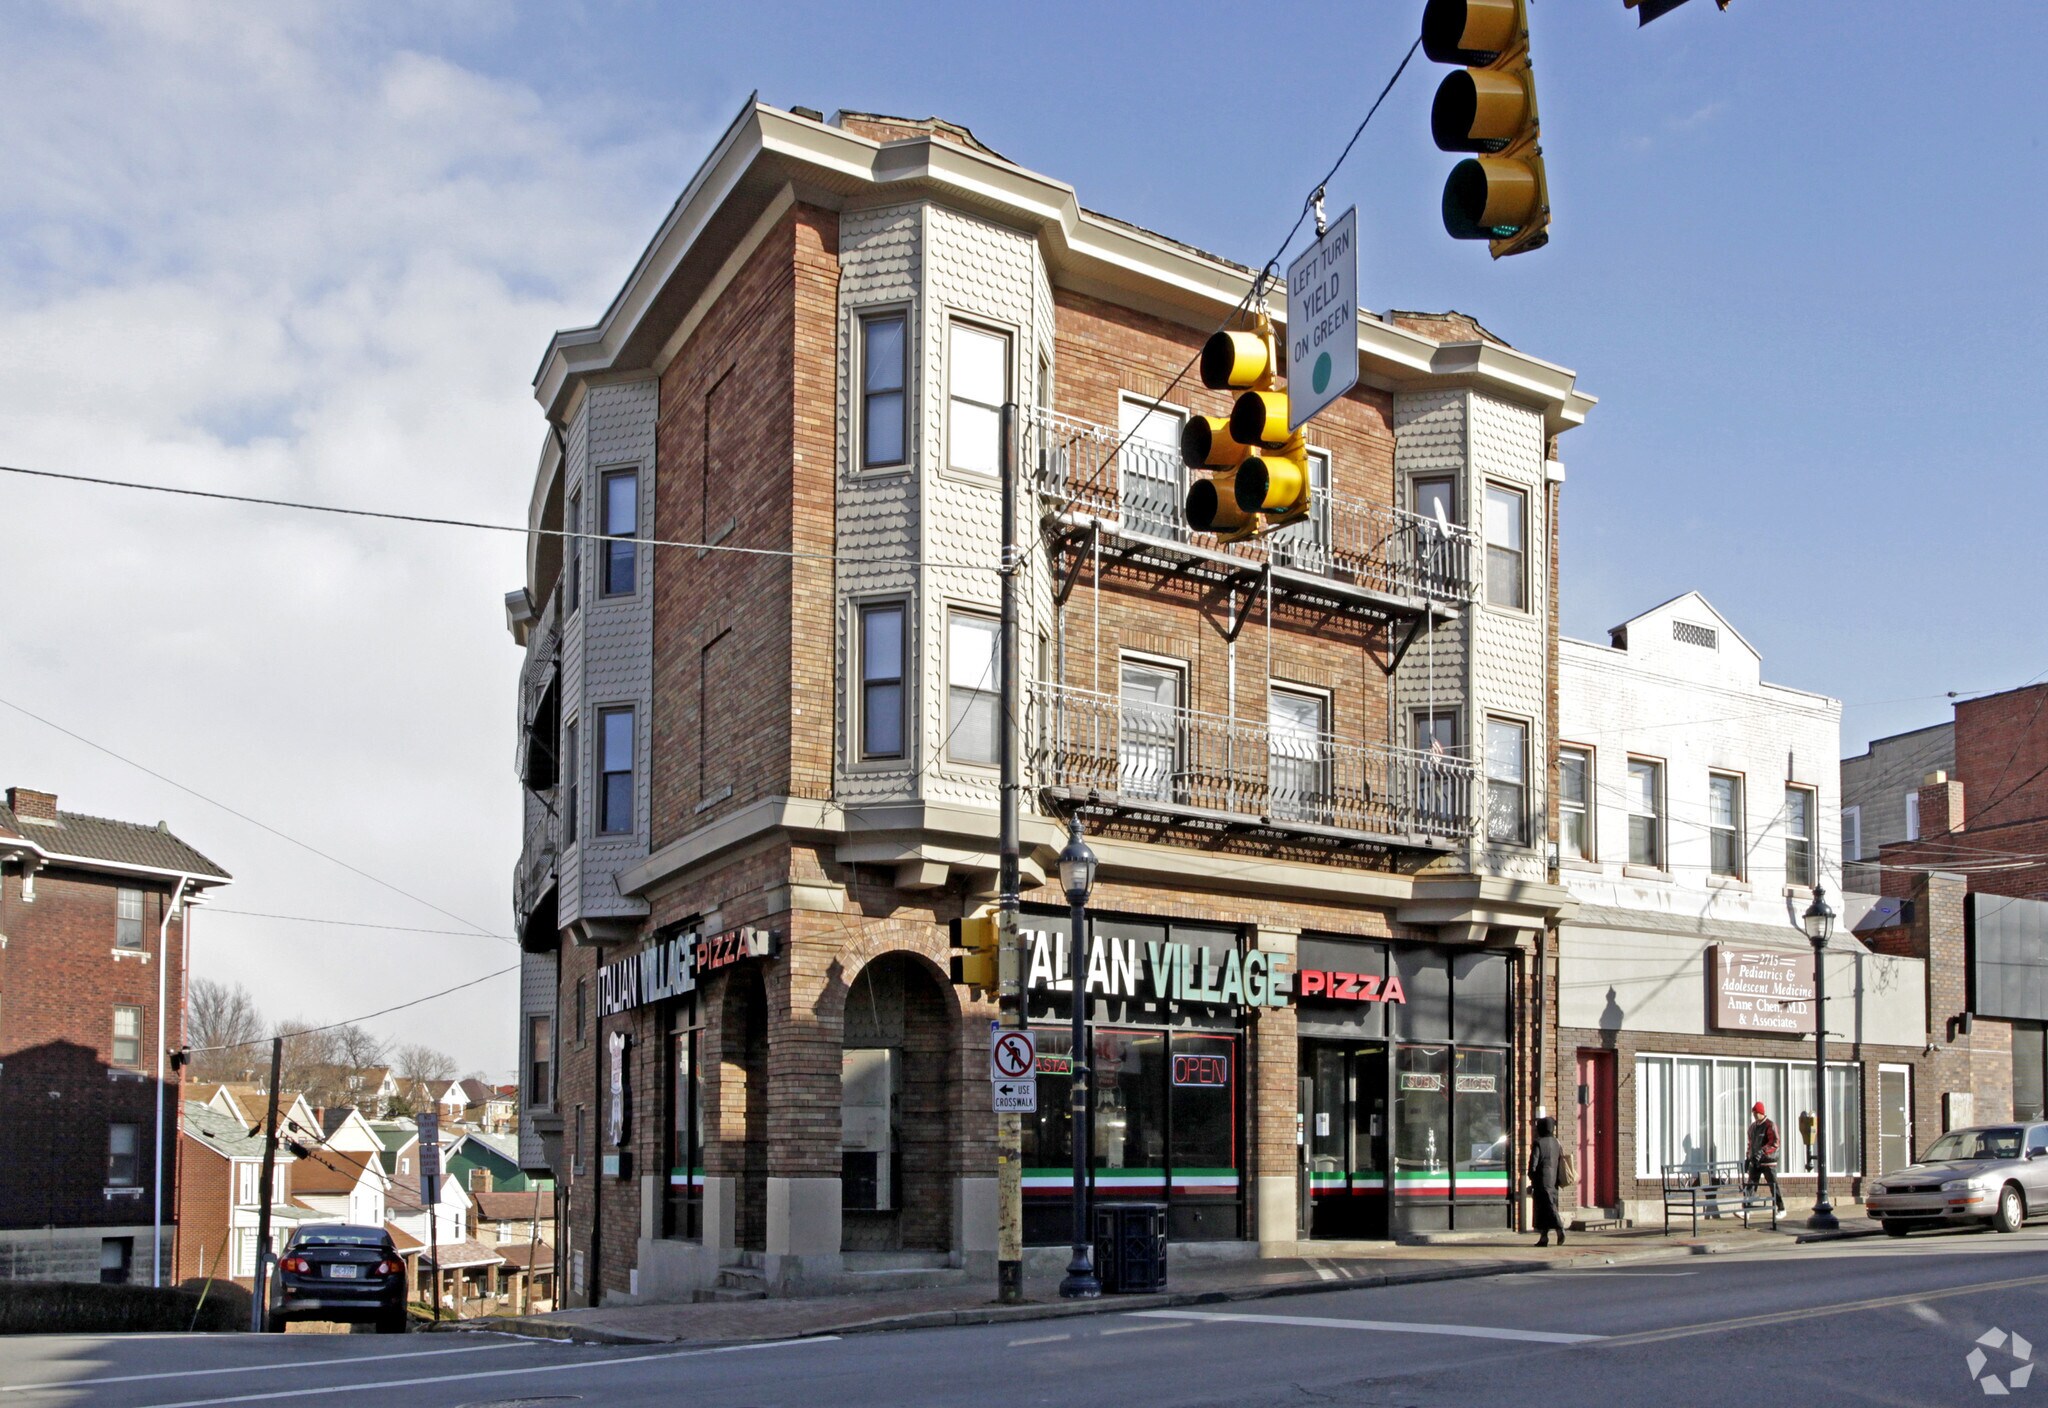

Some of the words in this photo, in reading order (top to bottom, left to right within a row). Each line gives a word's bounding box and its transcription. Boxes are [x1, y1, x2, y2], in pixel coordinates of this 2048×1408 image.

[1293, 257, 1317, 297] LEFT
[1322, 228, 1349, 272] TURN
[1303, 272, 1340, 322] YIELD
[1294, 334, 1309, 363] ON
[1313, 301, 1349, 347] GREEN
[1759, 953, 1779, 966] 2715
[598, 955, 637, 1017] ITALIAN
[640, 932, 696, 1004] VILLAGE
[697, 927, 752, 974] PIZZA
[1148, 941, 1288, 1007] VILLAGE
[1301, 969, 1406, 1004] PIZZA
[1739, 965, 1783, 981] Pediatrics
[1786, 969, 1796, 982] &
[1722, 978, 1768, 993] Adolescent
[1772, 983, 1813, 998] Medicine
[1727, 996, 1753, 1011] Anne
[1786, 1002, 1808, 1015] M.D.
[1739, 1013, 1747, 1025] &
[1752, 1014, 1797, 1028] Associates
[1036, 1058, 1069, 1073] ASTA
[1175, 1057, 1226, 1084] OPEN
[1018, 1085, 1030, 1095] USE
[1407, 1075, 1437, 1089] SUBS
[995, 1097, 1034, 1107] CROSSWALK
